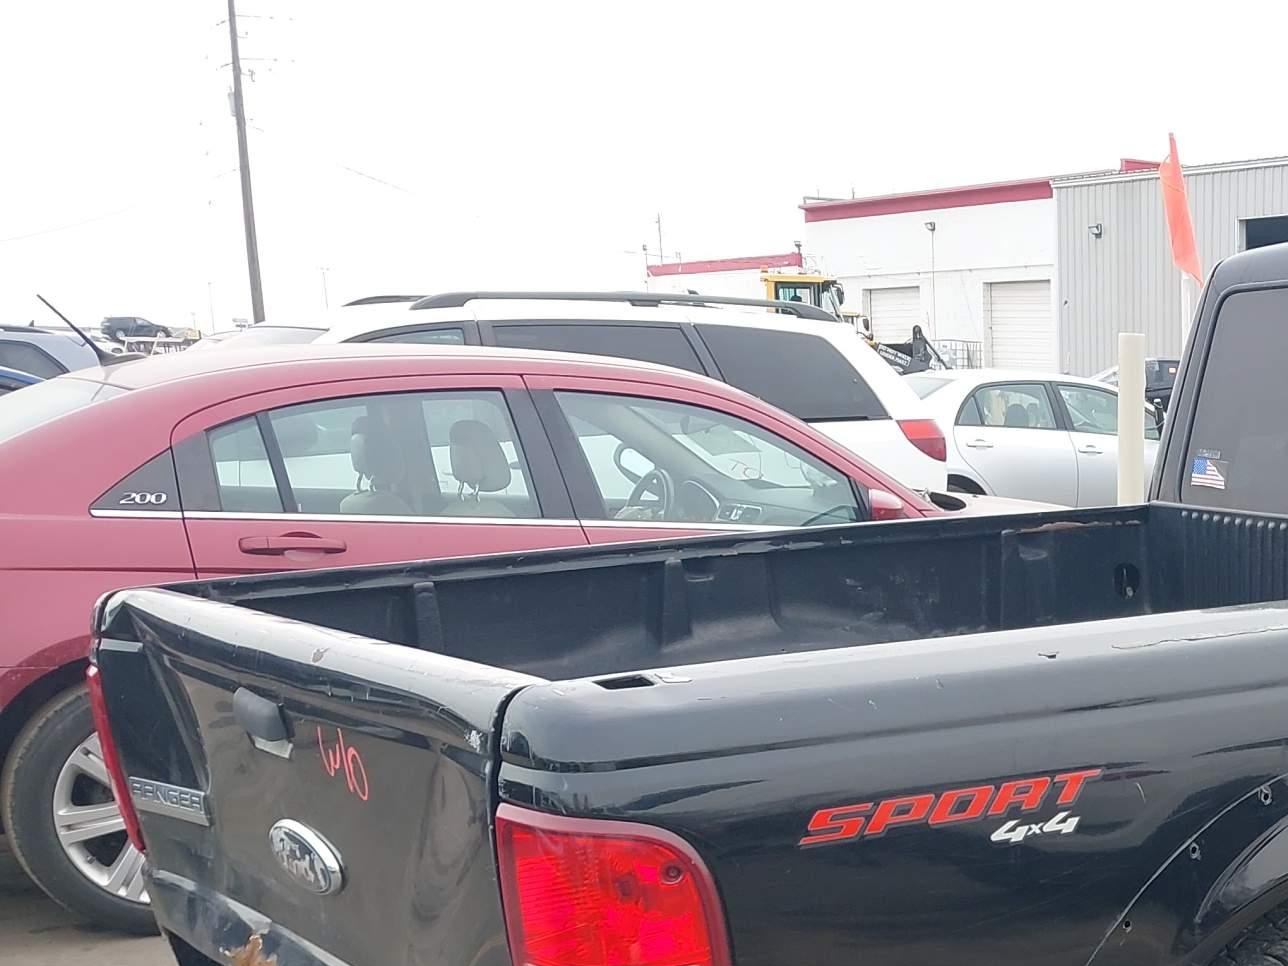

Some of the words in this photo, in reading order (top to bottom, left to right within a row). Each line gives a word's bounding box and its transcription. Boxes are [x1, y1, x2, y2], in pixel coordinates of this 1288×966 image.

[119, 491, 168, 505] 200
[132, 781, 203, 815] RANGER
[797, 769, 1103, 848] SPORT
